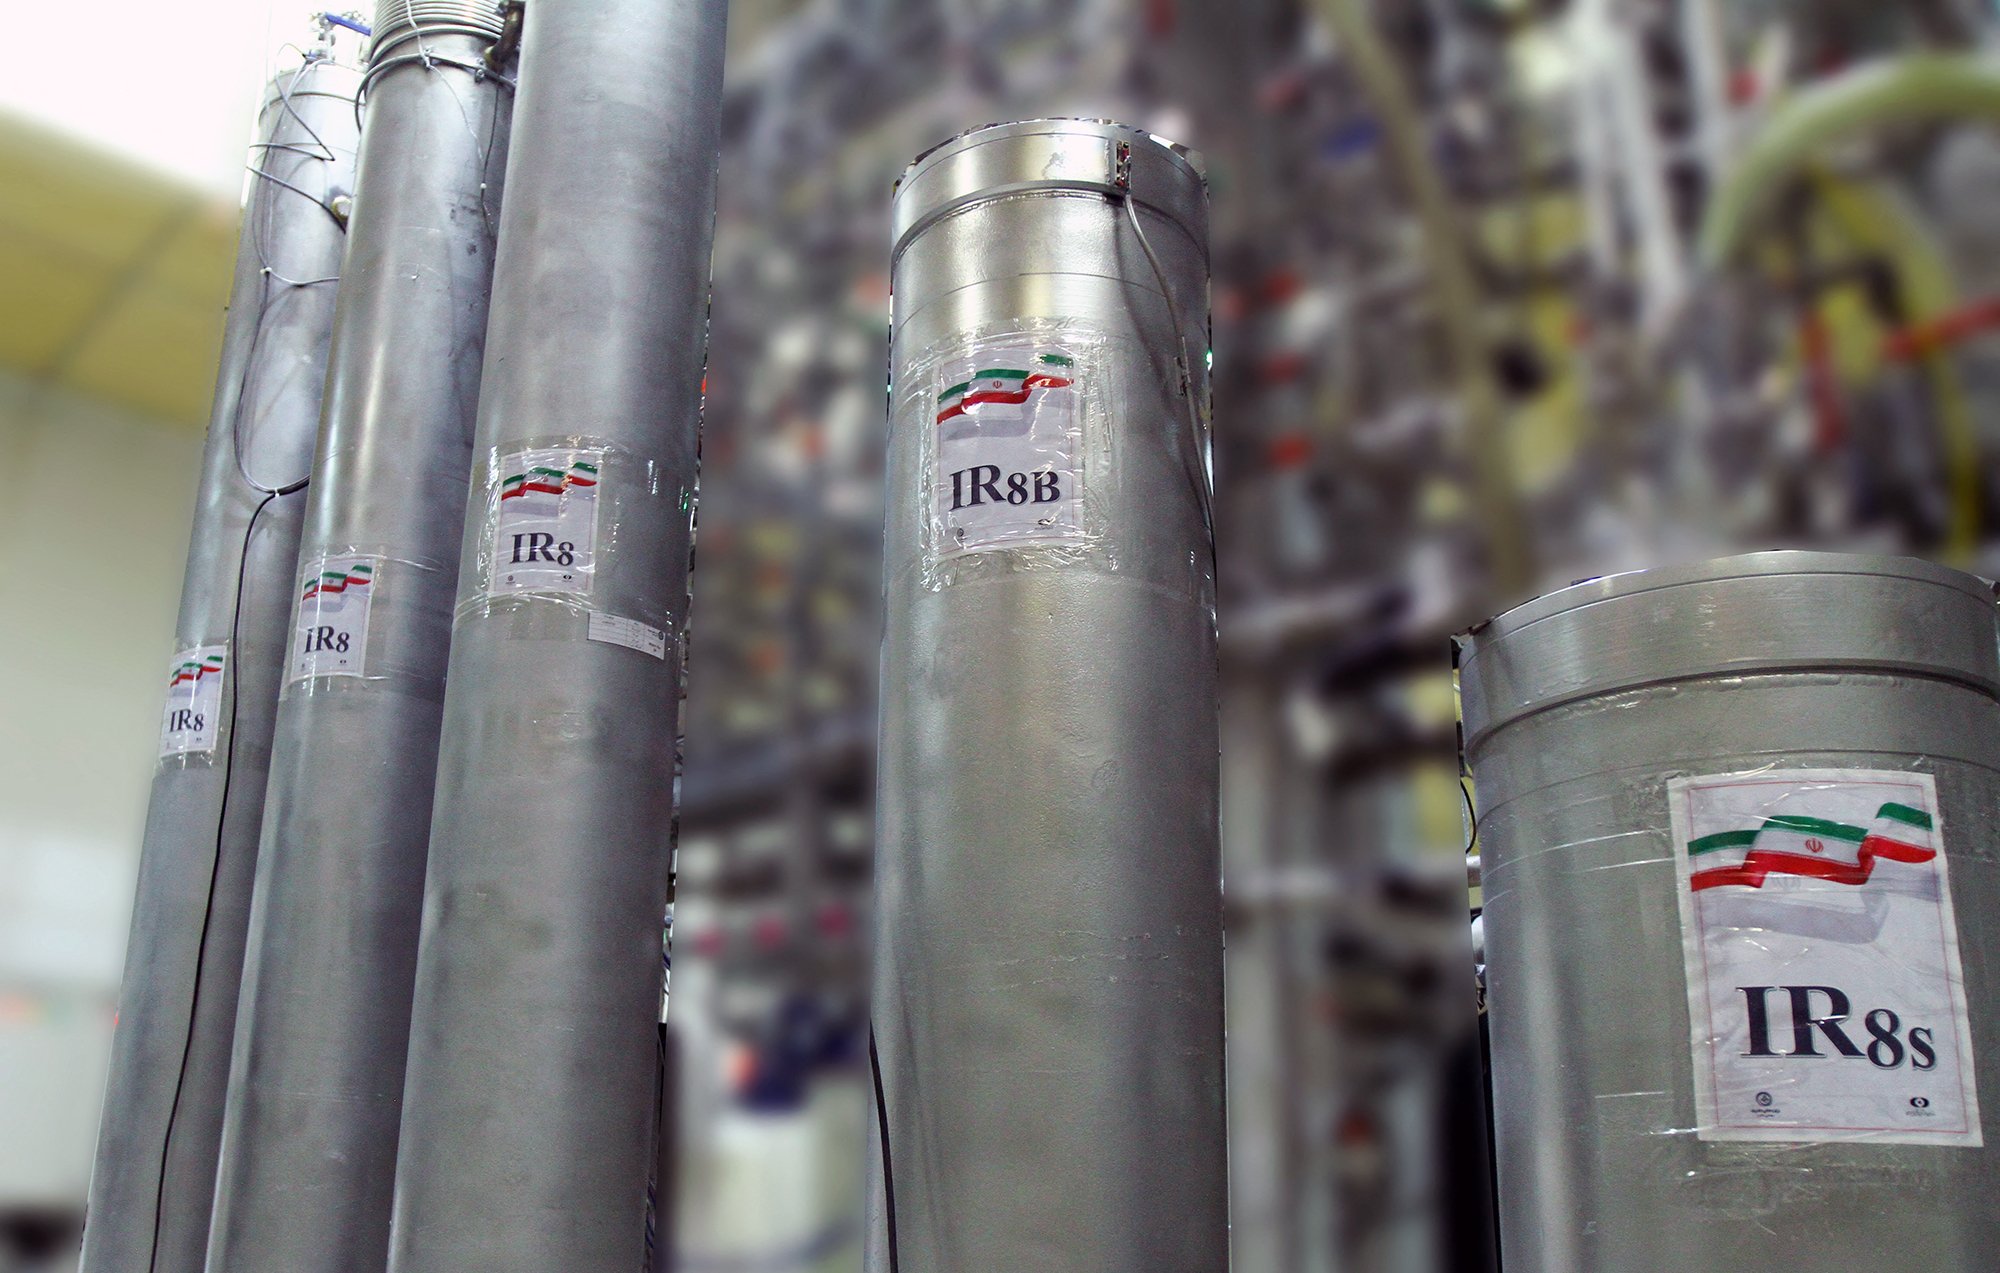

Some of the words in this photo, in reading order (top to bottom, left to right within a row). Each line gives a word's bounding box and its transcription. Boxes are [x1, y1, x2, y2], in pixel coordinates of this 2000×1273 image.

[949, 464, 1061, 512] IR8B
[510, 532, 575, 567] IR8
[304, 625, 350, 654] IR8
[169, 708, 205, 733] IR8
[1735, 985, 1937, 1070] IR8s
